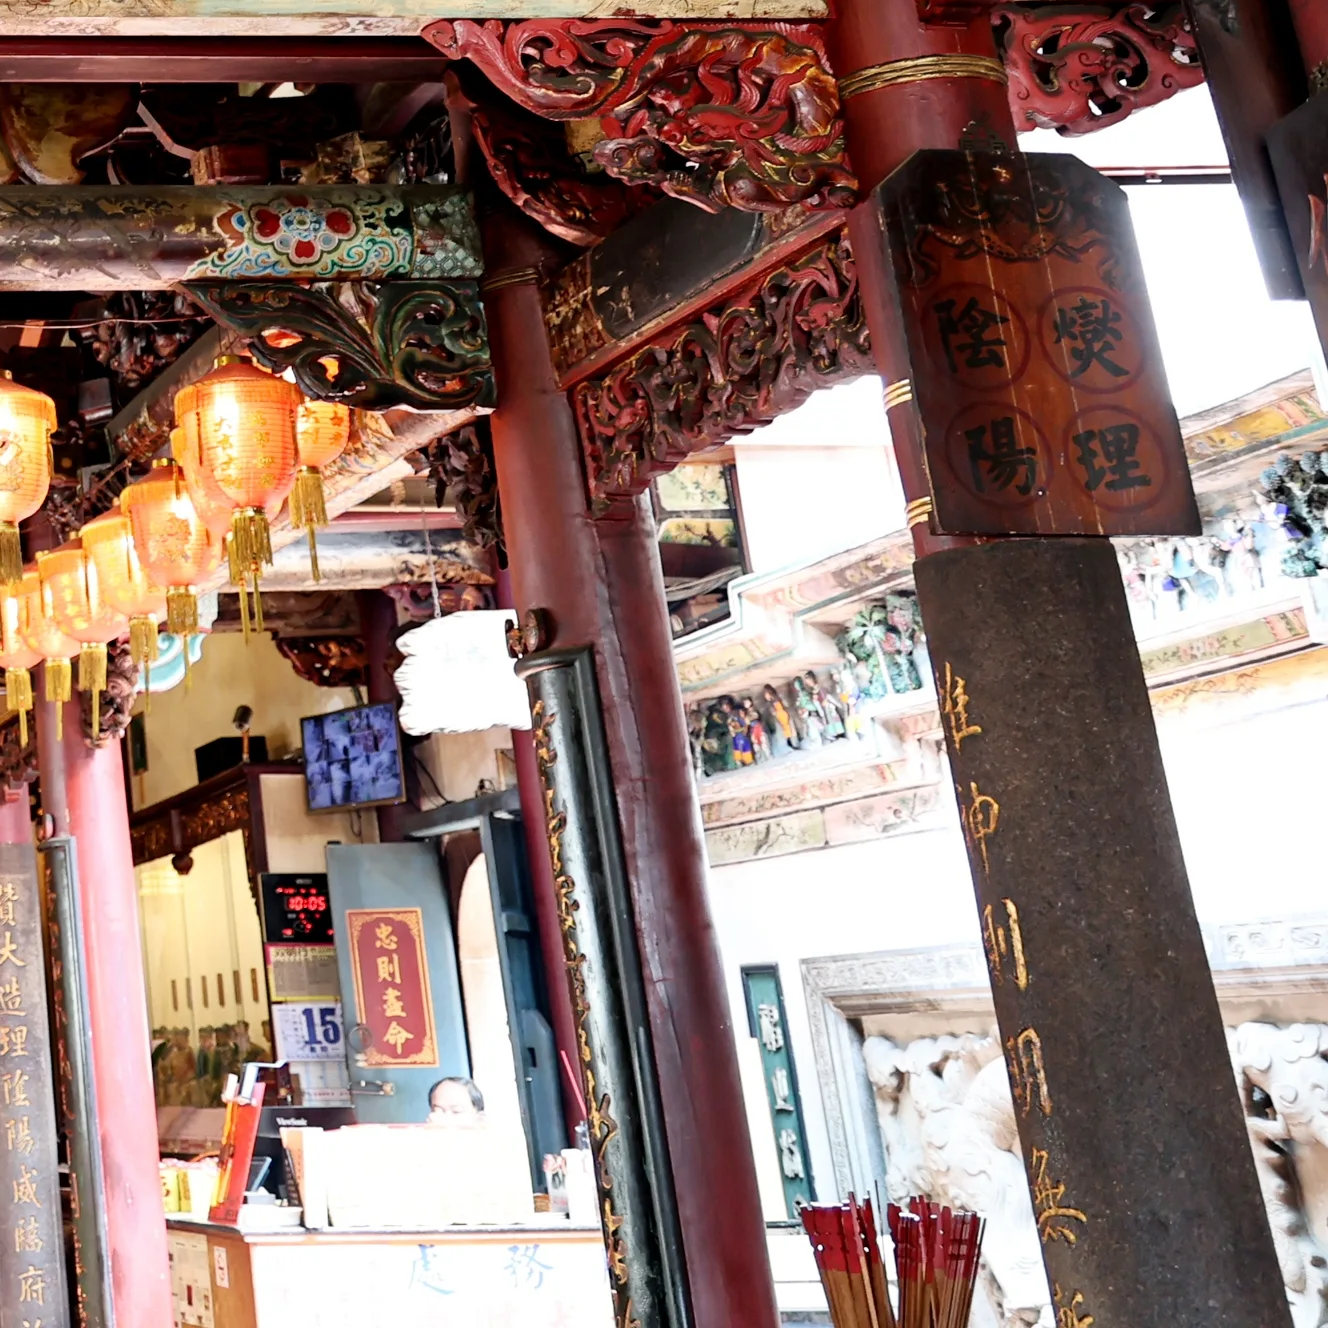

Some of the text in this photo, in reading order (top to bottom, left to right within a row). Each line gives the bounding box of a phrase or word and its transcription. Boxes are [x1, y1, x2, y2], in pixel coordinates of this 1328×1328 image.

[932, 296, 1042, 495] 陰陽
[288, 895, 327, 911] 10:05
[302, 1007, 341, 1045] 15
[375, 922, 414, 1055] 忠則盡命
